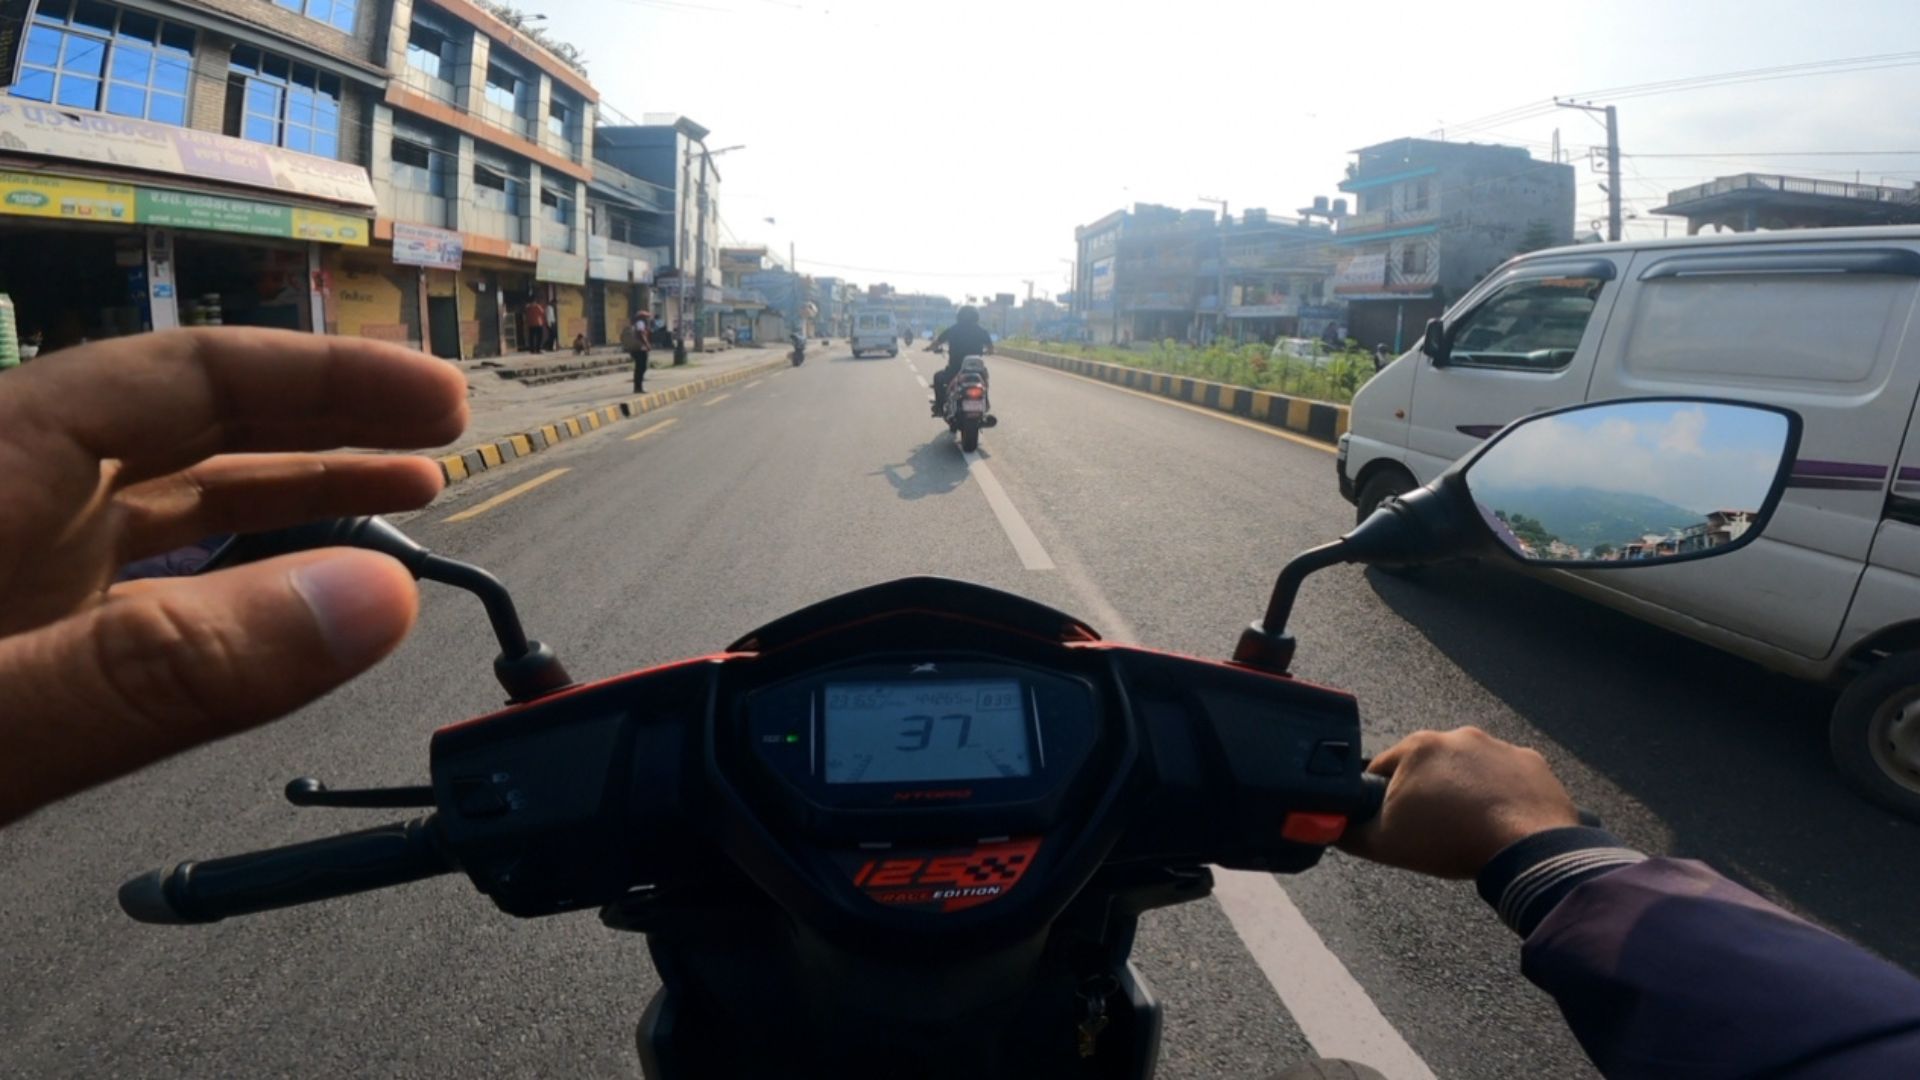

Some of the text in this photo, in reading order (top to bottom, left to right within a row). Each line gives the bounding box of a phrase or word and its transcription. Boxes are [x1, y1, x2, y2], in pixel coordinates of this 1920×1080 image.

[895, 713, 973, 752] 37
[853, 857, 968, 887] 125
[932, 886, 1001, 899] EDITION
